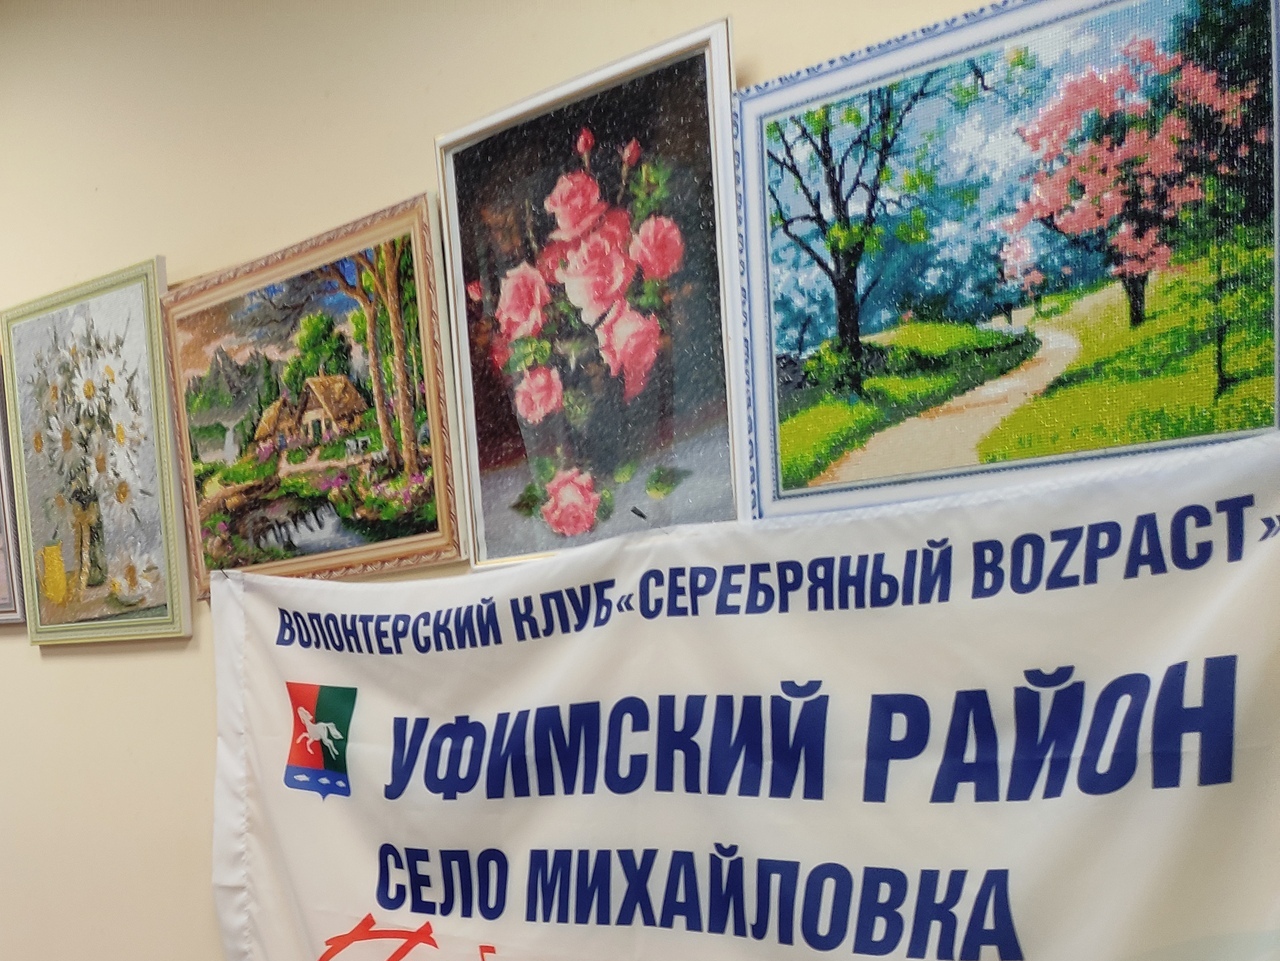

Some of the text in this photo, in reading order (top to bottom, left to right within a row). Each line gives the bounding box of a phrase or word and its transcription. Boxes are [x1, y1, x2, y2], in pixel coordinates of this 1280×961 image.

[276, 597, 503, 655] ВОЛОНТЕРСКИЙ
[510, 579, 617, 642] КЛУБ
[617, 538, 953, 620] «СЕРЕБРЯНЫЙ
[383, 655, 1238, 803] УФИМСКИЙ РАЙОН
[375, 842, 1025, 961] СЕЛО МИХАЙЛОВКА
